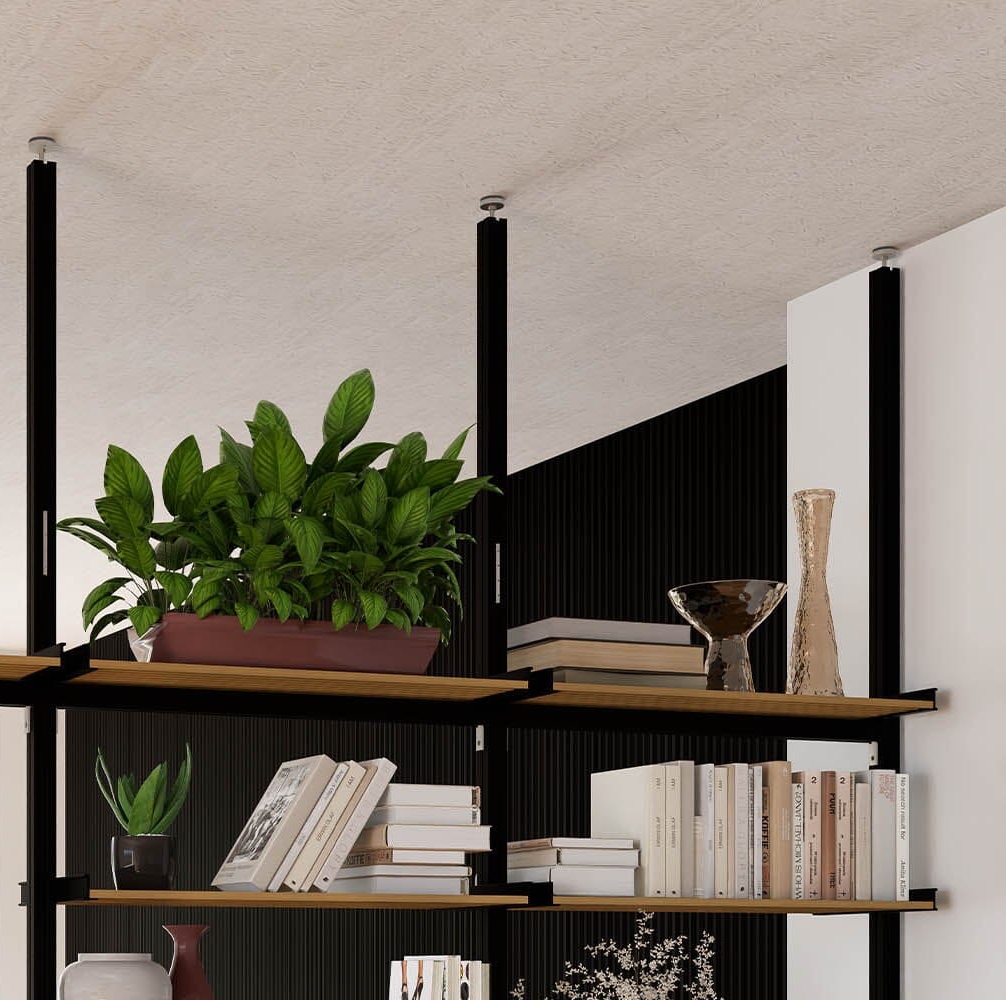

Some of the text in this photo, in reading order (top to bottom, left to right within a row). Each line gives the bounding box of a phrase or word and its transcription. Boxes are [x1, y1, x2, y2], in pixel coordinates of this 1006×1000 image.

[795, 821, 803, 863] MICHAEL
[795, 865, 803, 874] IS
[795, 876, 803, 899] WHO
